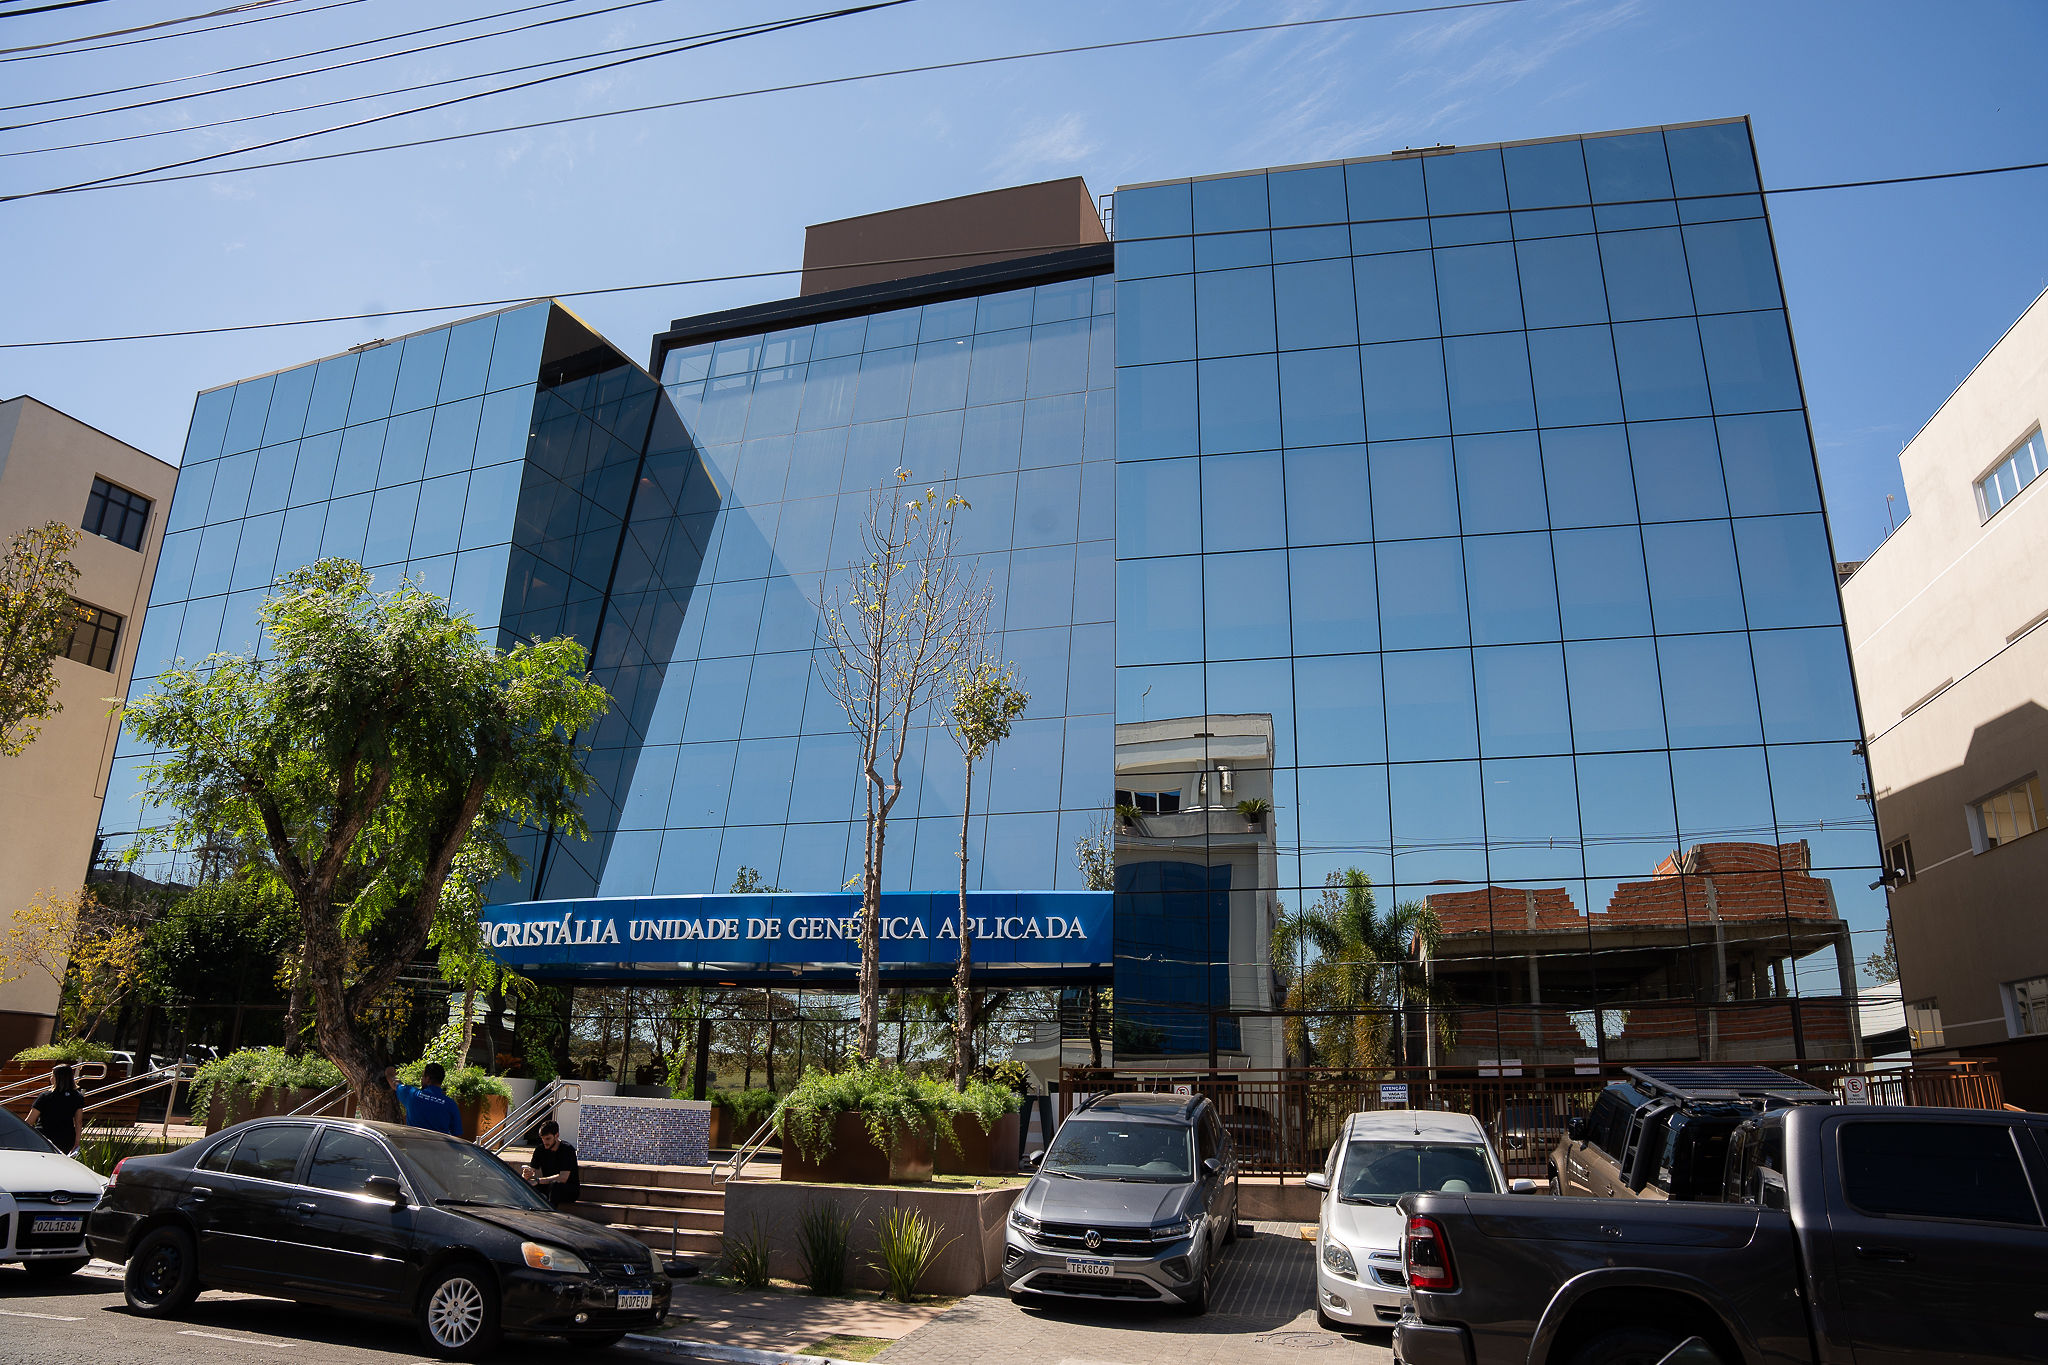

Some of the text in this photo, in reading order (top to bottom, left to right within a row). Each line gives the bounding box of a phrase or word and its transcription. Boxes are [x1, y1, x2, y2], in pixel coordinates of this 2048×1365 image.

[628, 918, 740, 941] UNIDADE
[746, 918, 781, 940] DE
[787, 911, 929, 940] GENÉICA
[36, 1221, 77, 1232] OZL1E84
[1071, 1263, 1110, 1275] TEK8C69
